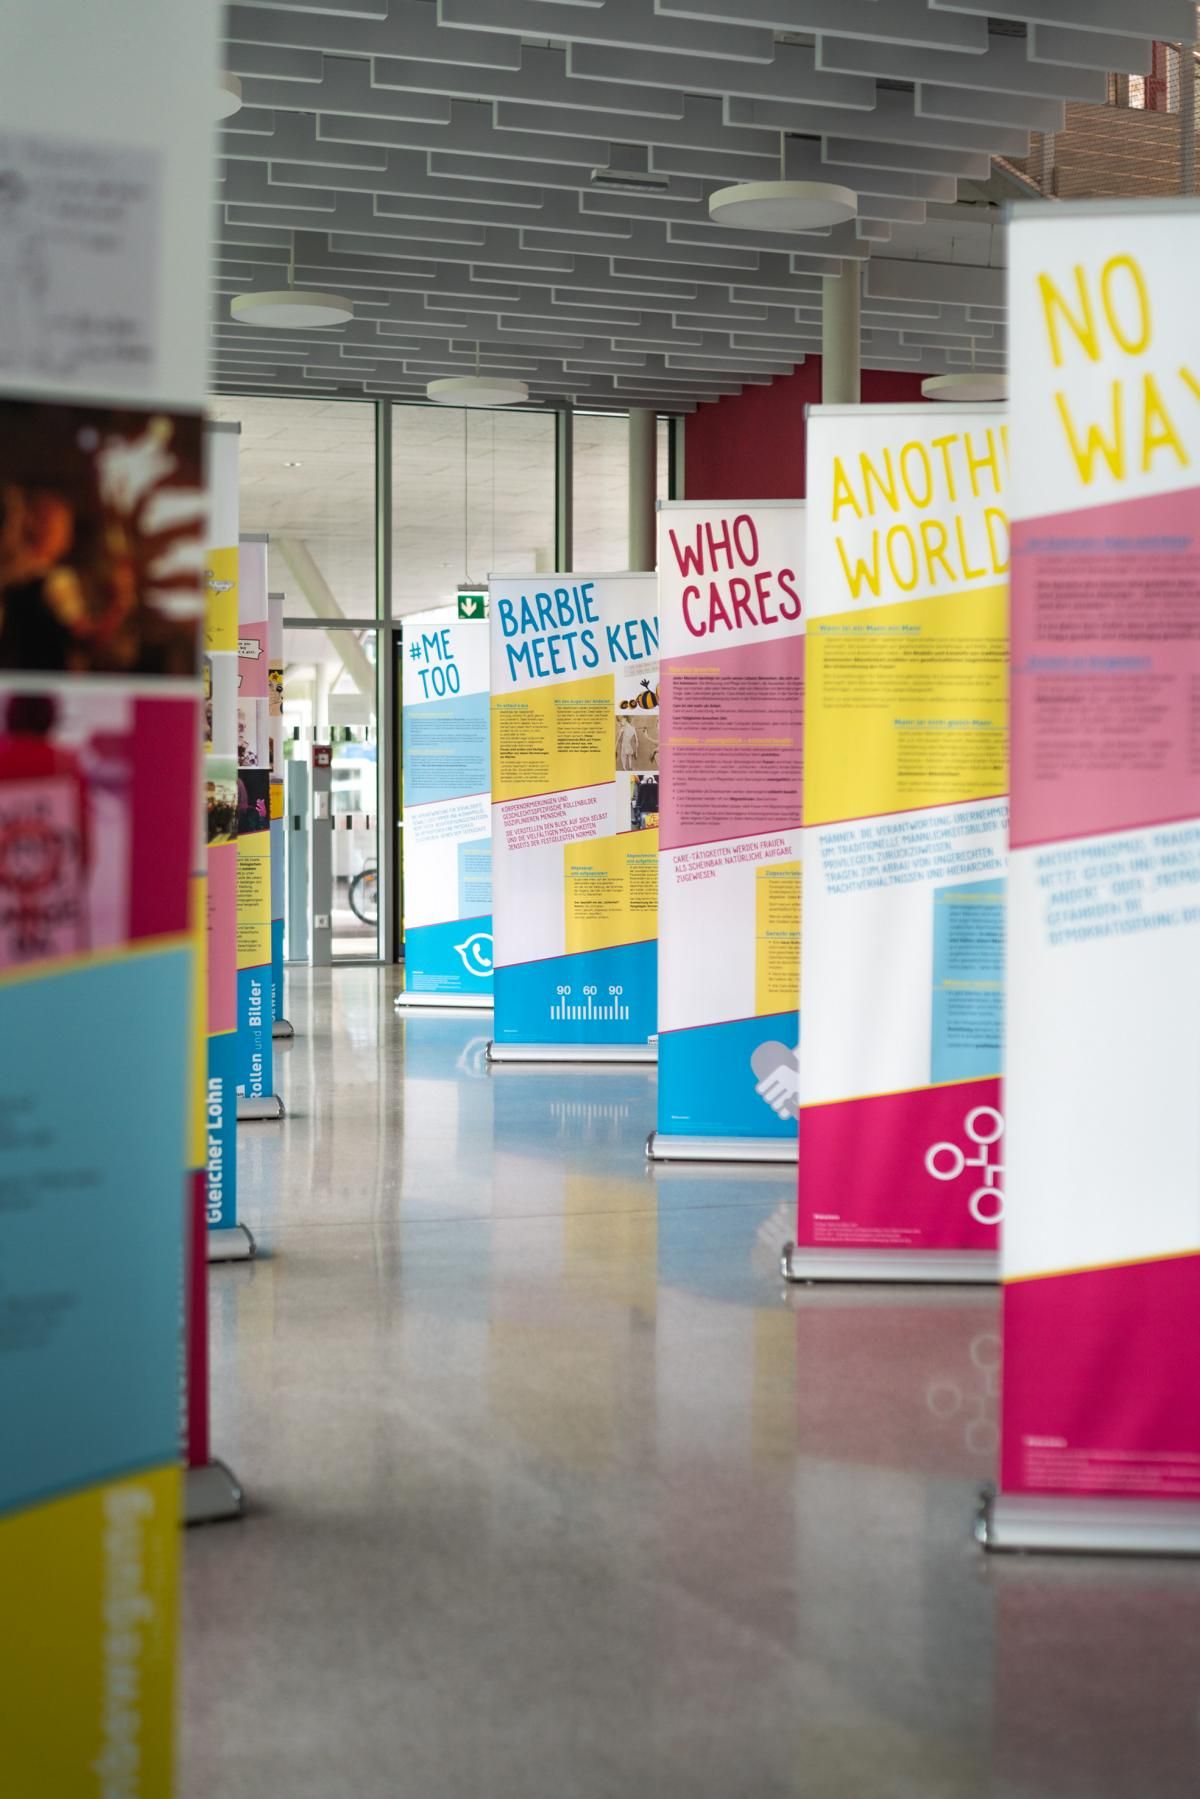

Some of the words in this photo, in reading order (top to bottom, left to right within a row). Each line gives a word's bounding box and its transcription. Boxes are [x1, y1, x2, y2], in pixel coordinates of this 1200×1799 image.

[1035, 251, 1152, 368] NO
[668, 514, 759, 578] WHO
[835, 507, 1009, 600] WORLD
[497, 582, 600, 637] BARBIE
[682, 568, 801, 638] CARES
[409, 629, 454, 663] #ME
[505, 629, 600, 682] MEETS
[605, 616, 659, 663] KEN
[418, 663, 461, 699] TOO
[760, 838, 785, 849] FRAUEN
[249, 979, 262, 1027] Bilder
[556, 985, 571, 995] 90
[583, 985, 597, 995] 60
[608, 985, 623, 995] 90
[206, 1077, 223, 1130] Lohn
[206, 1134, 223, 1224] Gleicher
